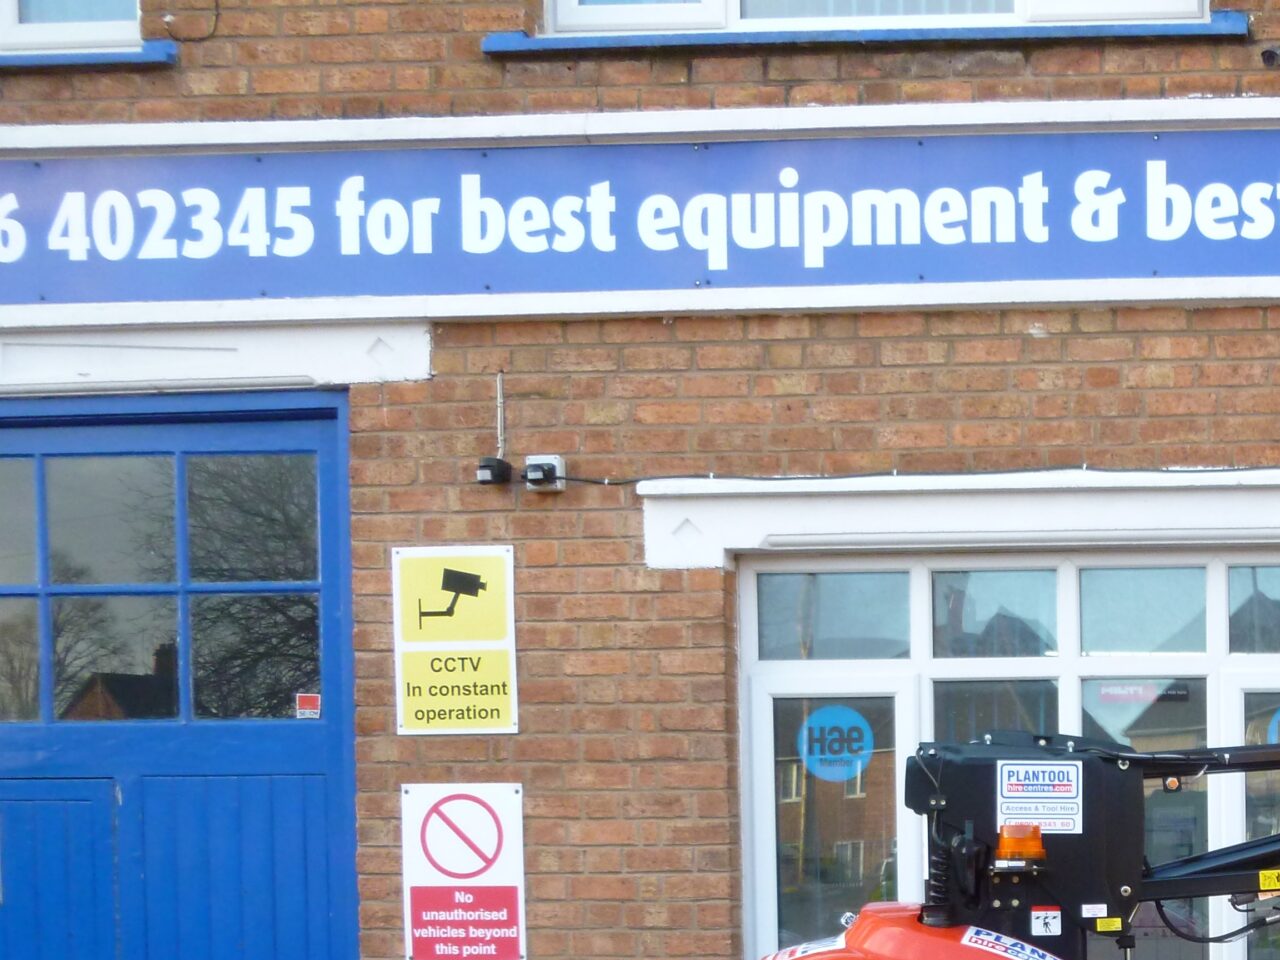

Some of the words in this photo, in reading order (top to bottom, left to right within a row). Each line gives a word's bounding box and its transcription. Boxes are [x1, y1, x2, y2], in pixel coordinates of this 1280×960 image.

[48, 185, 316, 261] 402345
[335, 175, 442, 256] for
[460, 173, 617, 254] best
[637, 166, 1050, 271] equipment
[1070, 169, 1127, 243] &
[430, 656, 481, 673] CCTV
[406, 682, 422, 697] In
[428, 681, 508, 697] constant
[414, 705, 500, 724] operation
[1007, 770, 1073, 782] PLANTOOL
[1007, 784, 1073, 792] hirecentres.com
[1060, 804, 1075, 812] Hire
[454, 891, 474, 903] No
[422, 908, 508, 921] unauthorised
[414, 926, 466, 938] vehicles
[469, 926, 518, 941] beyond
[435, 943, 460, 955] this
[462, 943, 497, 957] point
